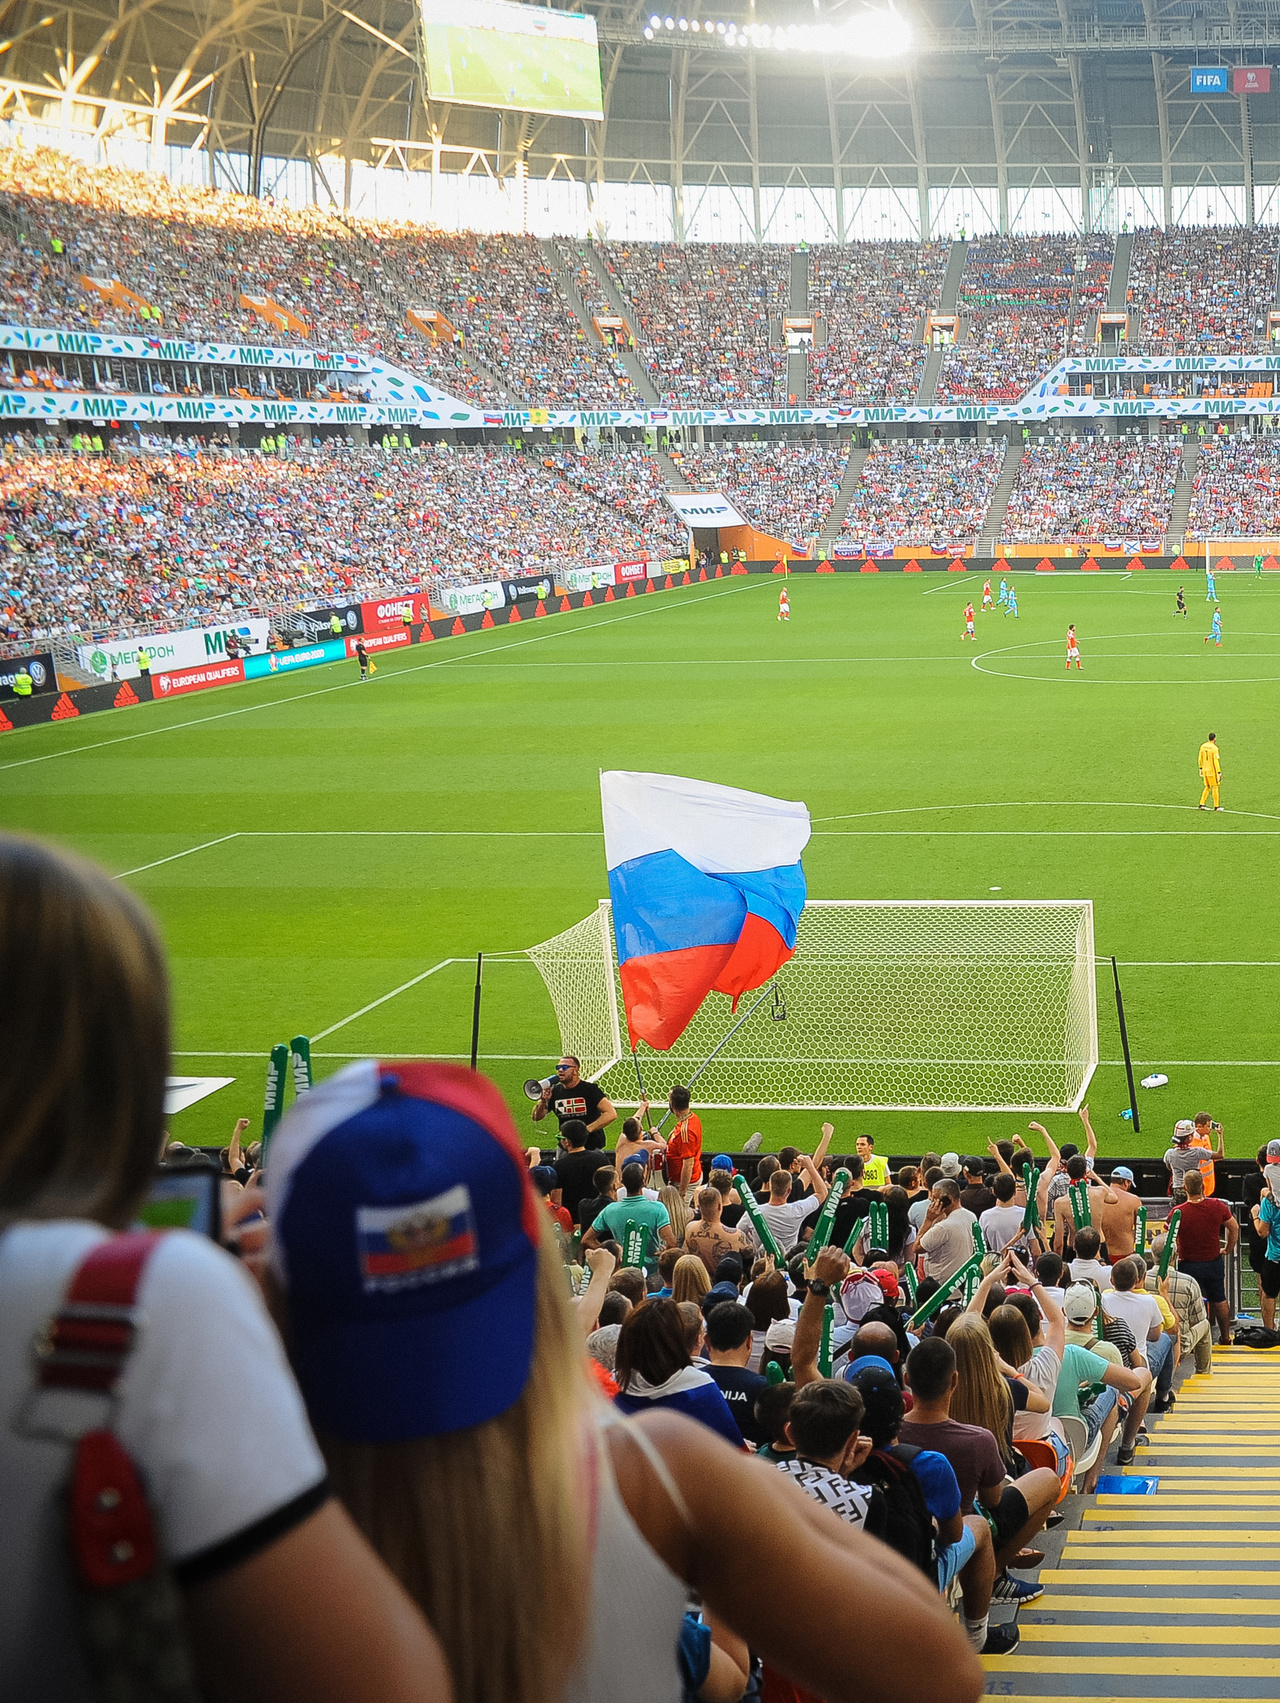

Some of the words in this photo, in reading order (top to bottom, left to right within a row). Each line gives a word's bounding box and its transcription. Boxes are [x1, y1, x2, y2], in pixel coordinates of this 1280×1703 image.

[1196, 75, 1221, 86] FIFA
[56, 333, 102, 353] МИР
[158, 342, 196, 360] МИР
[239, 347, 274, 365] МИР
[1085, 358, 1126, 371] МИР
[1175, 357, 1217, 370] МИР
[83, 398, 127, 417] МИР
[176, 401, 215, 419] МИР
[263, 404, 297, 420] МИР
[336, 405, 367, 421] МИР
[864, 407, 906, 421] МИР
[956, 406, 999, 420] МИР
[1113, 401, 1155, 414] МИР
[1204, 400, 1246, 413] МИР
[388, 408, 417, 422] МИР
[502, 412, 530, 426] МИР
[580, 412, 621, 425] МИР
[672, 411, 716, 424] МИР
[769, 410, 812, 423] МИР
[680, 506, 728, 515] МИР
[110, 645, 175, 666] МЕГФОН
[280, 655, 295, 665] UEFA
[172, 671, 206, 688] EUROPEAN
[207, 666, 239, 682] QUALIFIERS
[264, 1061, 279, 1110] МИР
[740, 1182, 762, 1216] МИР
[823, 1180, 844, 1218] МИР
[1135, 1215, 1143, 1244] МИР
[632, 1232, 643, 1264] МИР
[579, 1265, 591, 1295] МИР
[987, 1681, 1015, 1695] 13
